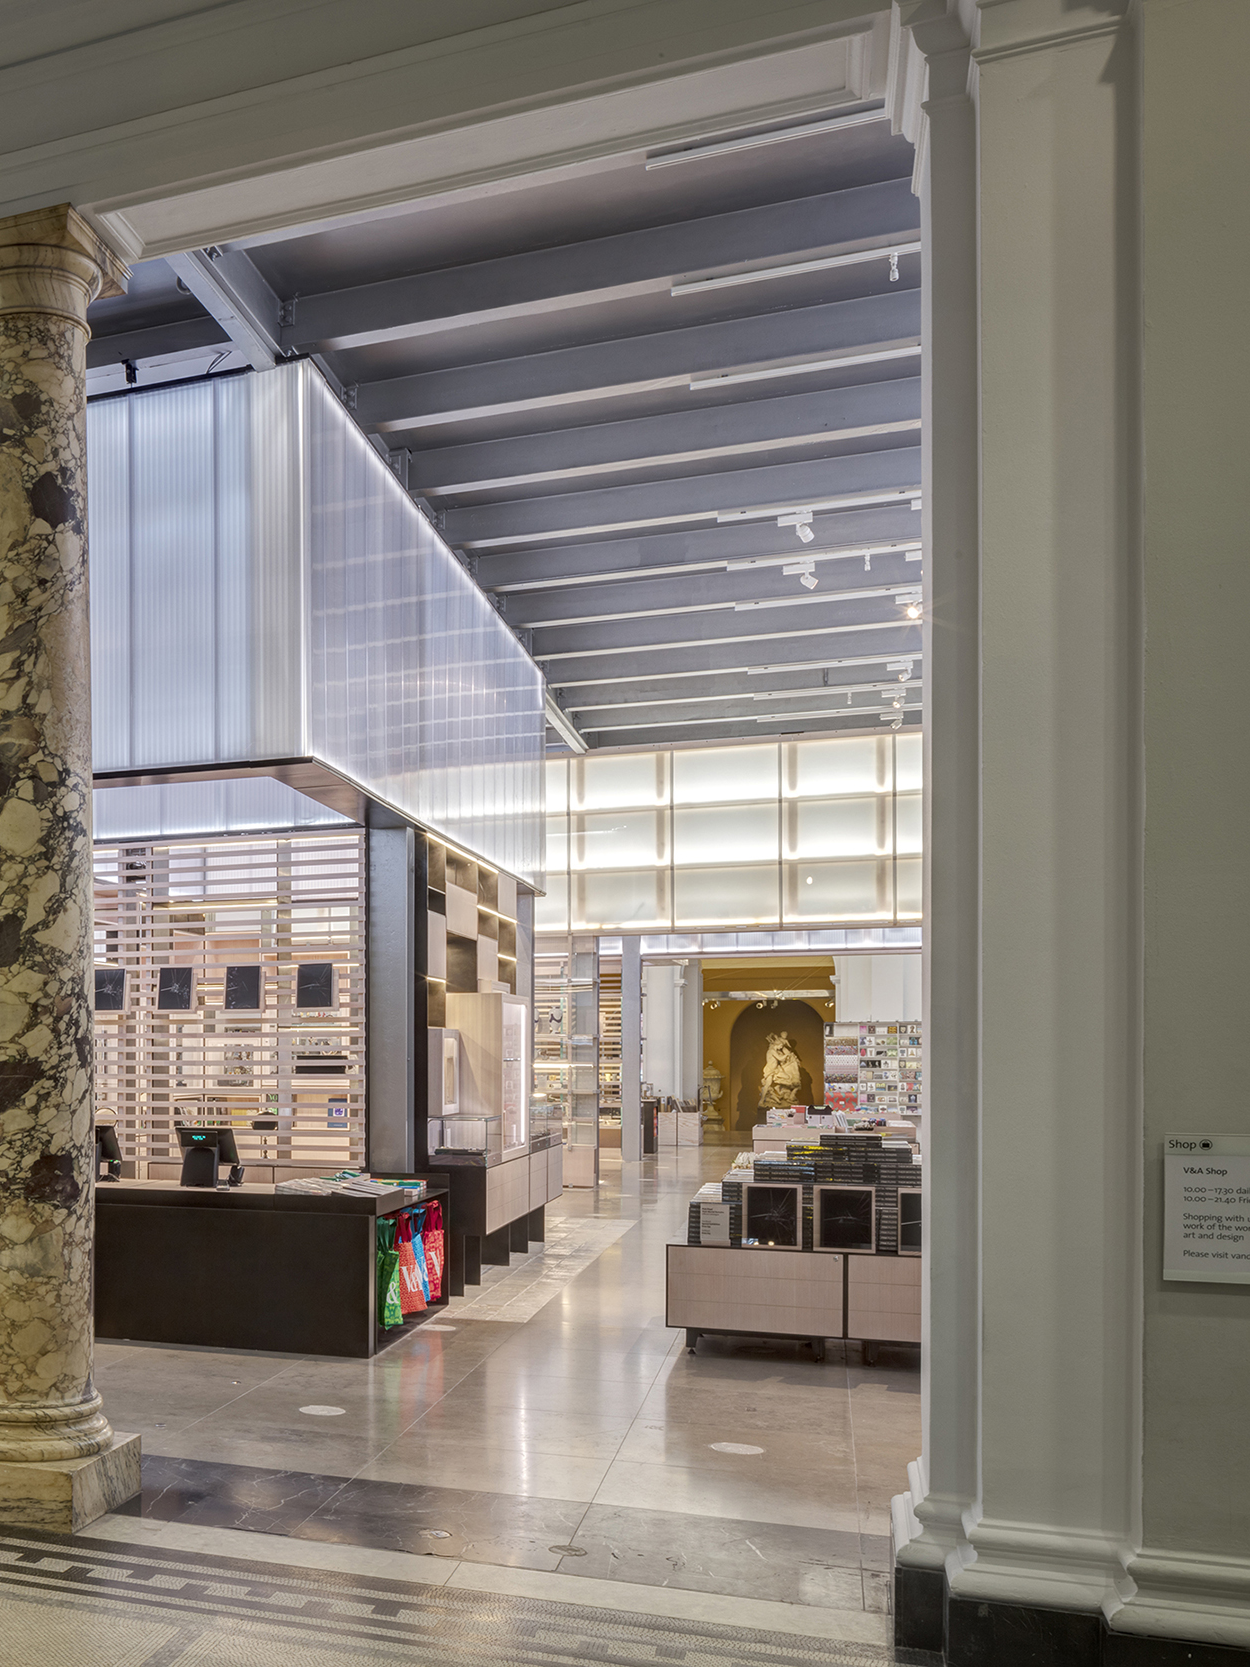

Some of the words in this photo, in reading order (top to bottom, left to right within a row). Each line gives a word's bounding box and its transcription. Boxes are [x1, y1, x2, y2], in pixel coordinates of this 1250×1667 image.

[1168, 1139, 1197, 1152] Shop
[1183, 1166, 1204, 1175] V&A
[1205, 1167, 1228, 1177] Shop
[1183, 1212, 1223, 1224] Shopping
[1206, 1223, 1216, 1231] of
[1197, 1232, 1214, 1240] and
[1216, 1233, 1244, 1243] design
[1183, 1250, 1210, 1258] Please
